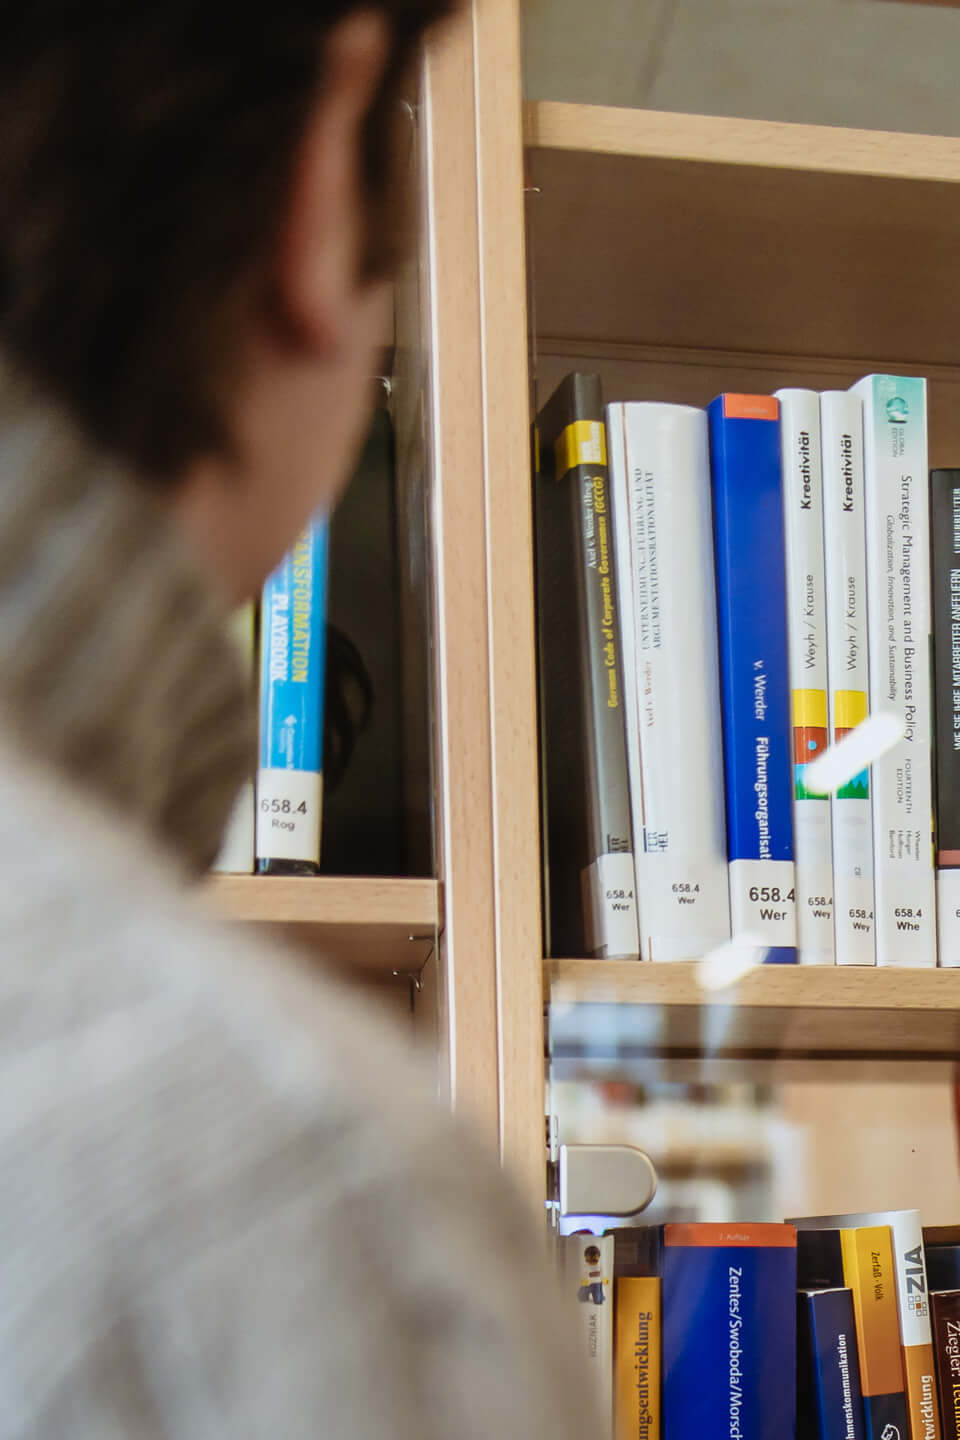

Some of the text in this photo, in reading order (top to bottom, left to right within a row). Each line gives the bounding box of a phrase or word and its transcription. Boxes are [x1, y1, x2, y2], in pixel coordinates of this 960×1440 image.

[800, 431, 816, 670] Weyh Krause Kreativität
[842, 434, 857, 671] Weyh Krause Kreativität
[900, 475, 917, 743] Strategic Management and Business Policy
[904, 758, 912, 814] FOURTEENTH
[260, 798, 308, 815] 658.4
[748, 887, 796, 902] 658.4
[760, 909, 788, 921] Wer
[894, 908, 923, 918] 658.4
[896, 921, 921, 931] Whe
[903, 1244, 926, 1295] ZIA
